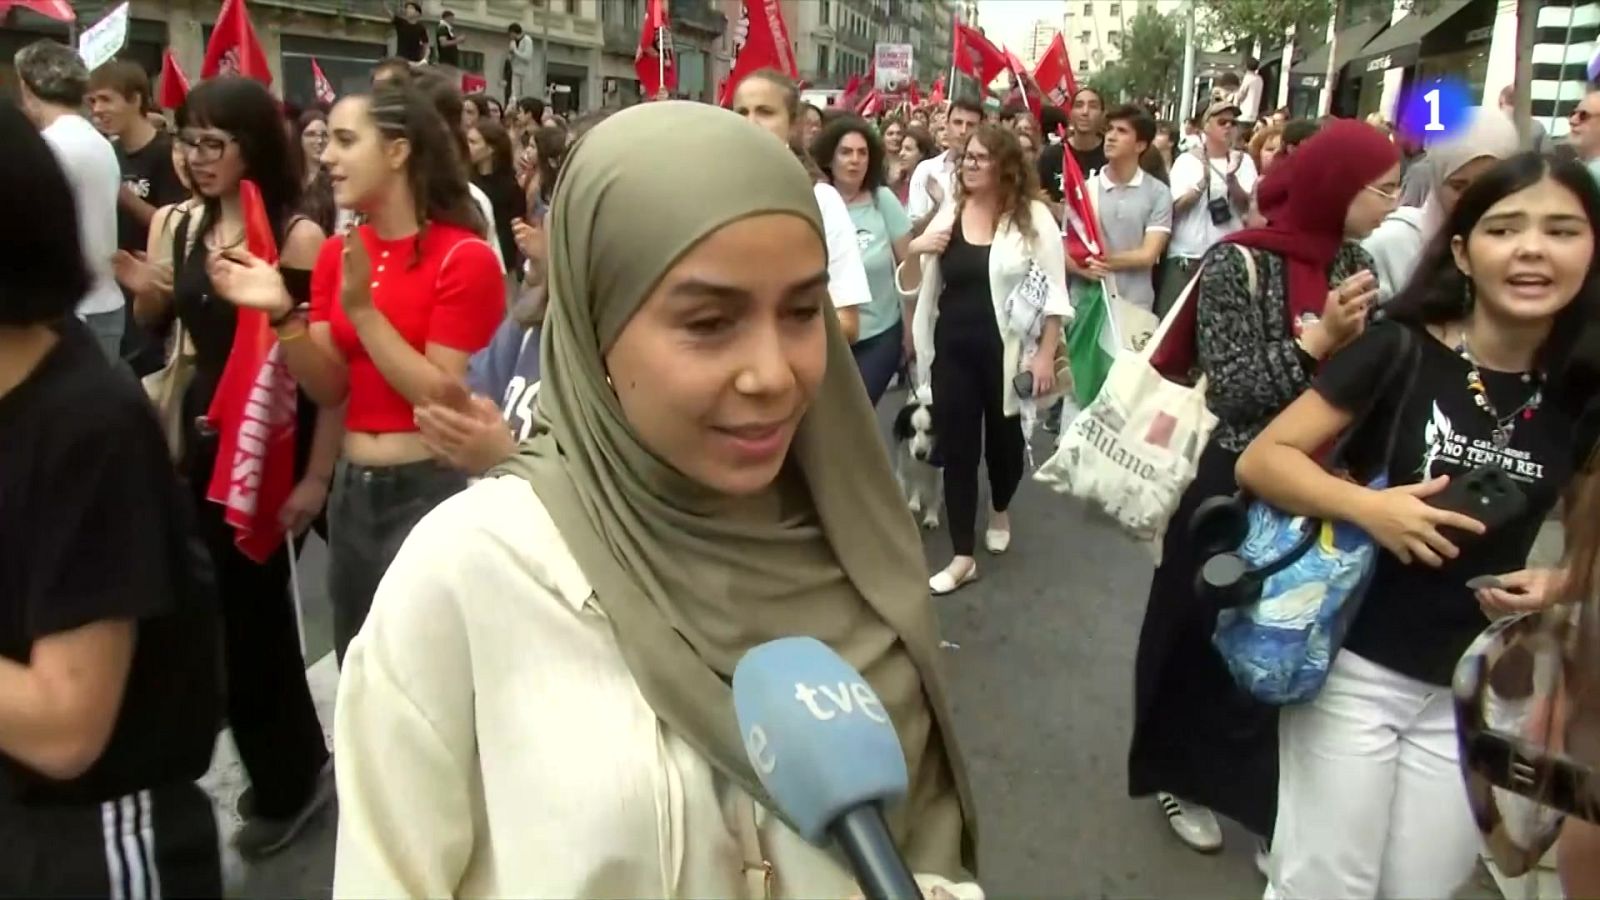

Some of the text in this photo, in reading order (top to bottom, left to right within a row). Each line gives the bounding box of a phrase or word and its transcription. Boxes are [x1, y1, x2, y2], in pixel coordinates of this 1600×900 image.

[1077, 418, 1158, 481] Milano
[1443, 441, 1463, 457] NO
[1466, 446, 1514, 470] TENIM
[1516, 459, 1545, 479] REI
[794, 681, 887, 725] tve
